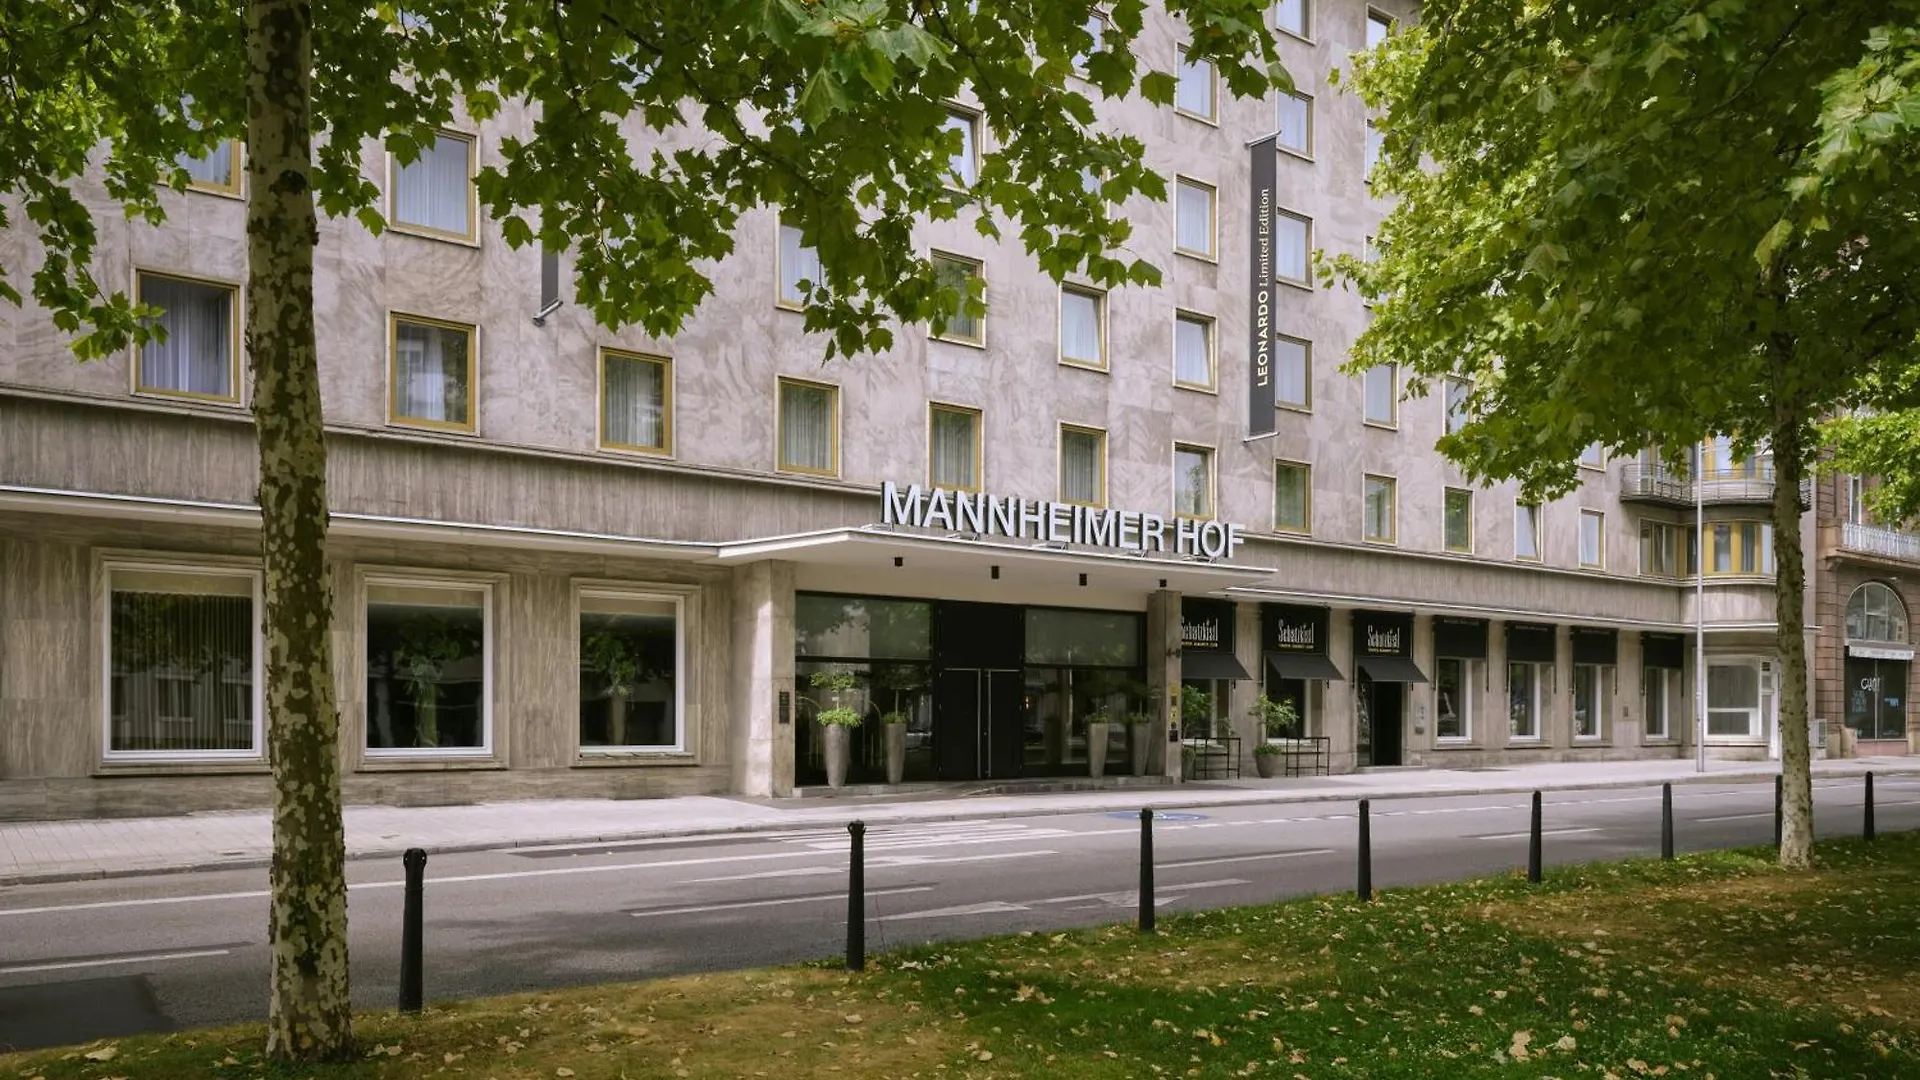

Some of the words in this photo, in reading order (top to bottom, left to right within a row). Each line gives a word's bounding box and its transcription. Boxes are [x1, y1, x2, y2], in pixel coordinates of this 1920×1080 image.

[1258, 188, 1269, 235] Edition
[1258, 238, 1269, 287] Limited
[1257, 290, 1269, 387] LEONARDO
[881, 481, 1165, 552] MANNHEIMER
[1173, 517, 1246, 558] HOF
